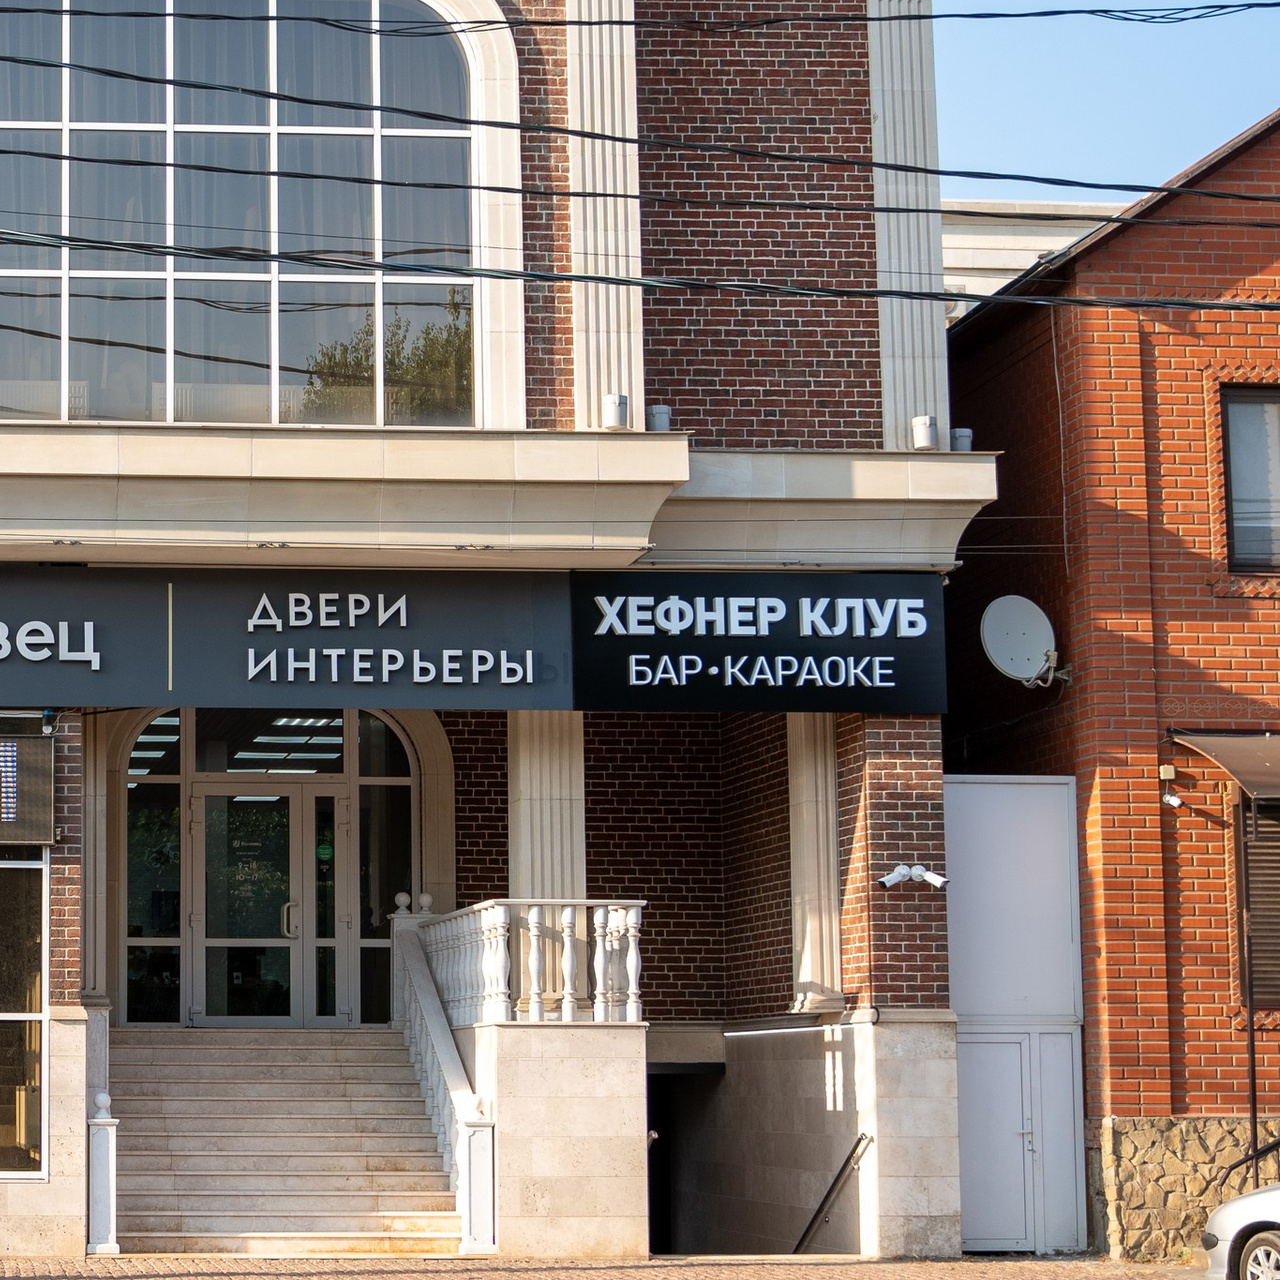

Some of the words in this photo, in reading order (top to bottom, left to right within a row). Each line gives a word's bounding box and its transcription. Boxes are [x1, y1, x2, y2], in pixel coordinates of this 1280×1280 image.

[247, 592, 409, 633] ДВЕРИ
[594, 595, 787, 637] ХЕФНЕР
[799, 597, 928, 639] КЛУБ
[247, 648, 534, 685] ИНТЕРЬЕРЫ
